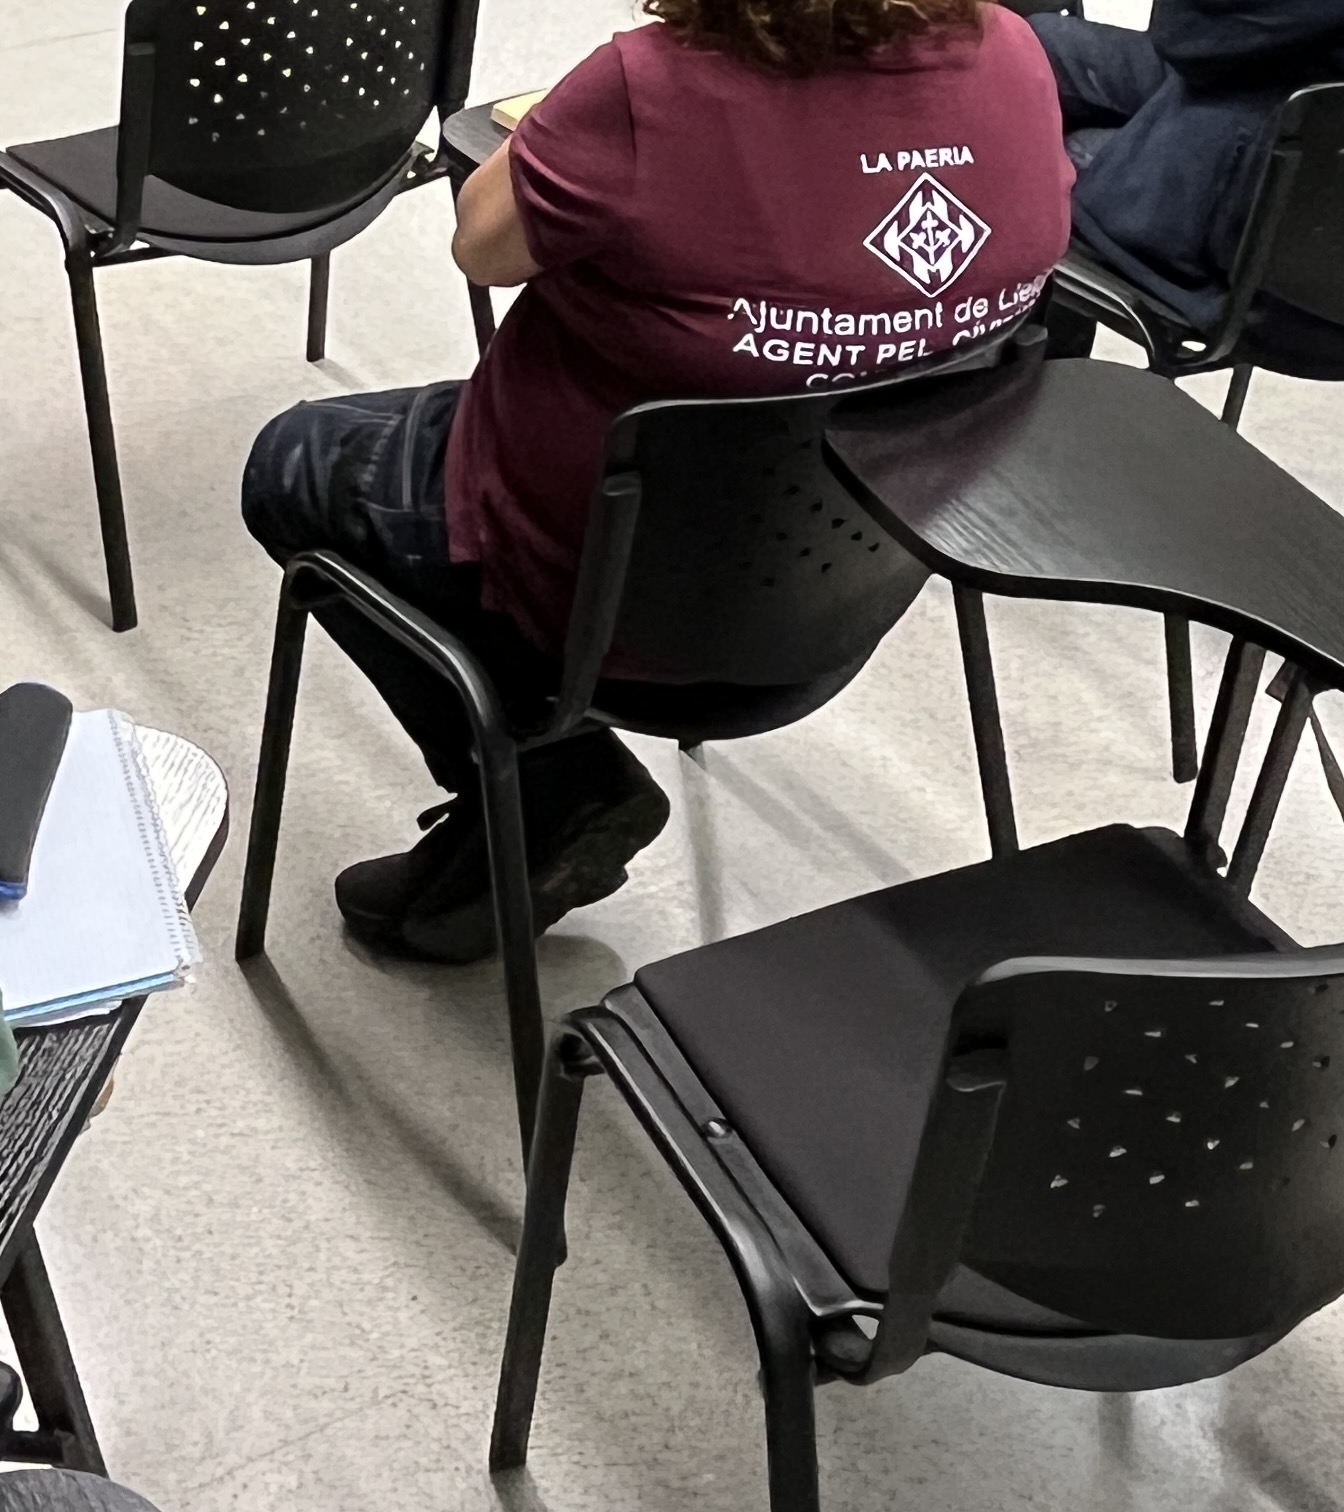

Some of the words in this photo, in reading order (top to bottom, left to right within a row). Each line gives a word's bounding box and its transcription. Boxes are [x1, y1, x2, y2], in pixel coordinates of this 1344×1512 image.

[860, 152, 893, 174] LA
[897, 146, 975, 170] PAERIA
[727, 297, 944, 337] Ajuntament
[953, 295, 989, 323] de
[732, 332, 867, 367] AGENT
